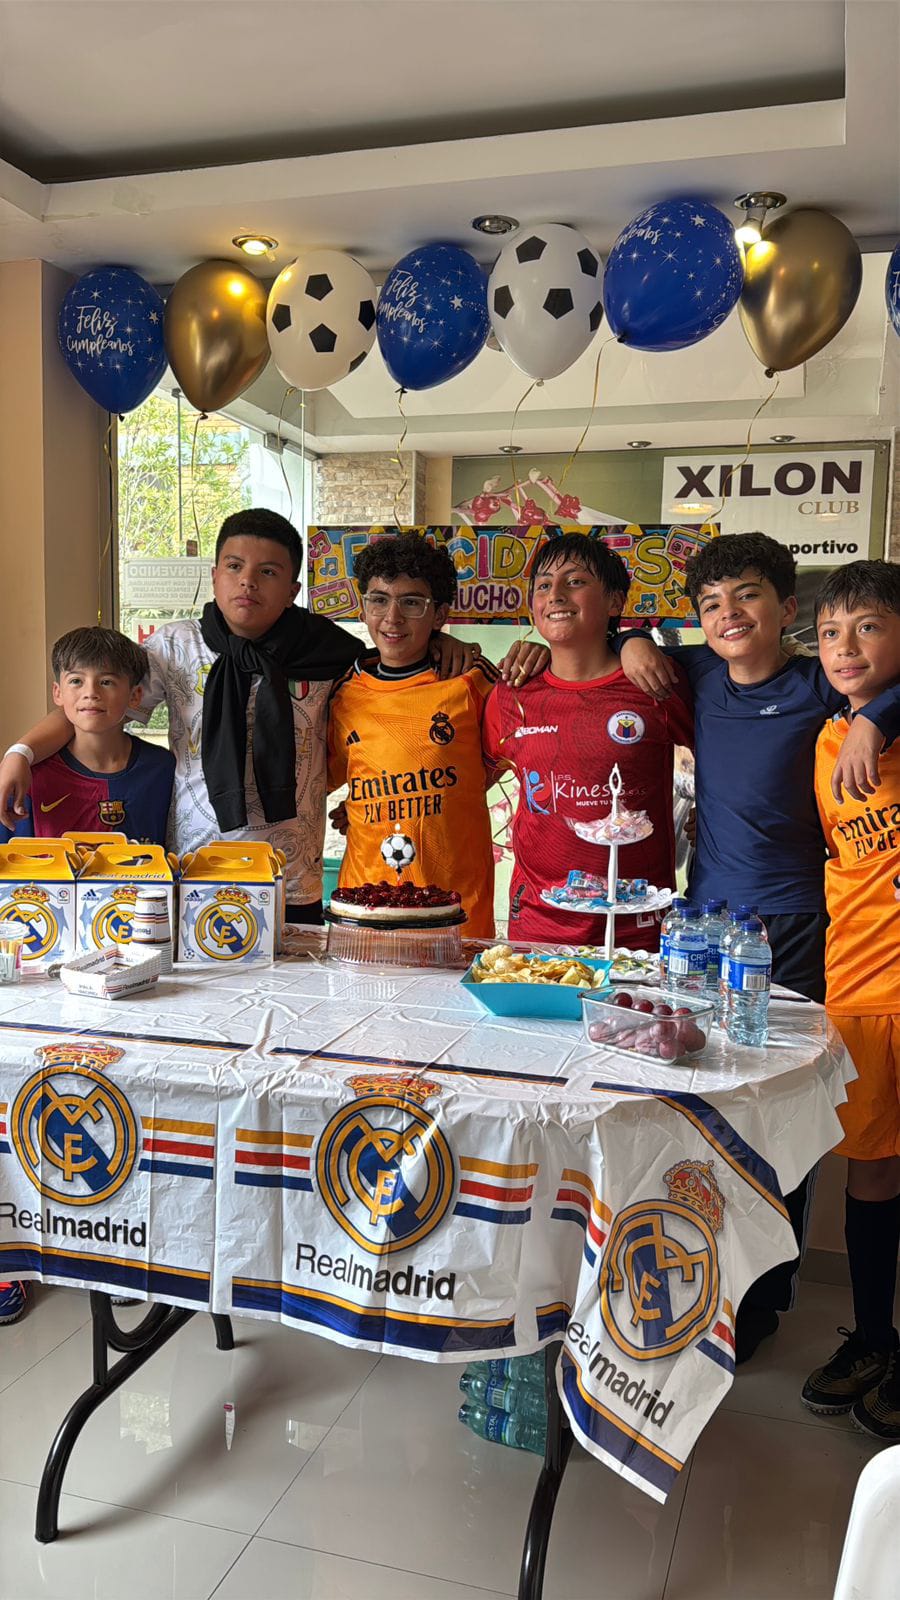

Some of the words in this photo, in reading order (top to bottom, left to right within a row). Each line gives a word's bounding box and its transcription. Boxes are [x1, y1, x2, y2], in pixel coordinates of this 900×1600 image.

[386, 269, 422, 308] Feliz
[76, 305, 119, 338] Feliz
[674, 461, 862, 498] XILON
[798, 500, 859, 515] CLUB
[789, 540, 858, 554] portivo
[351, 765, 457, 801] Emirates
[364, 802, 382, 824] FLY
[388, 794, 442, 821] BETTER
[0, 1202, 147, 1248] Realmadrid
[295, 1242, 456, 1300] Realmadrid
[567, 1321, 675, 1428] ealmadrid
